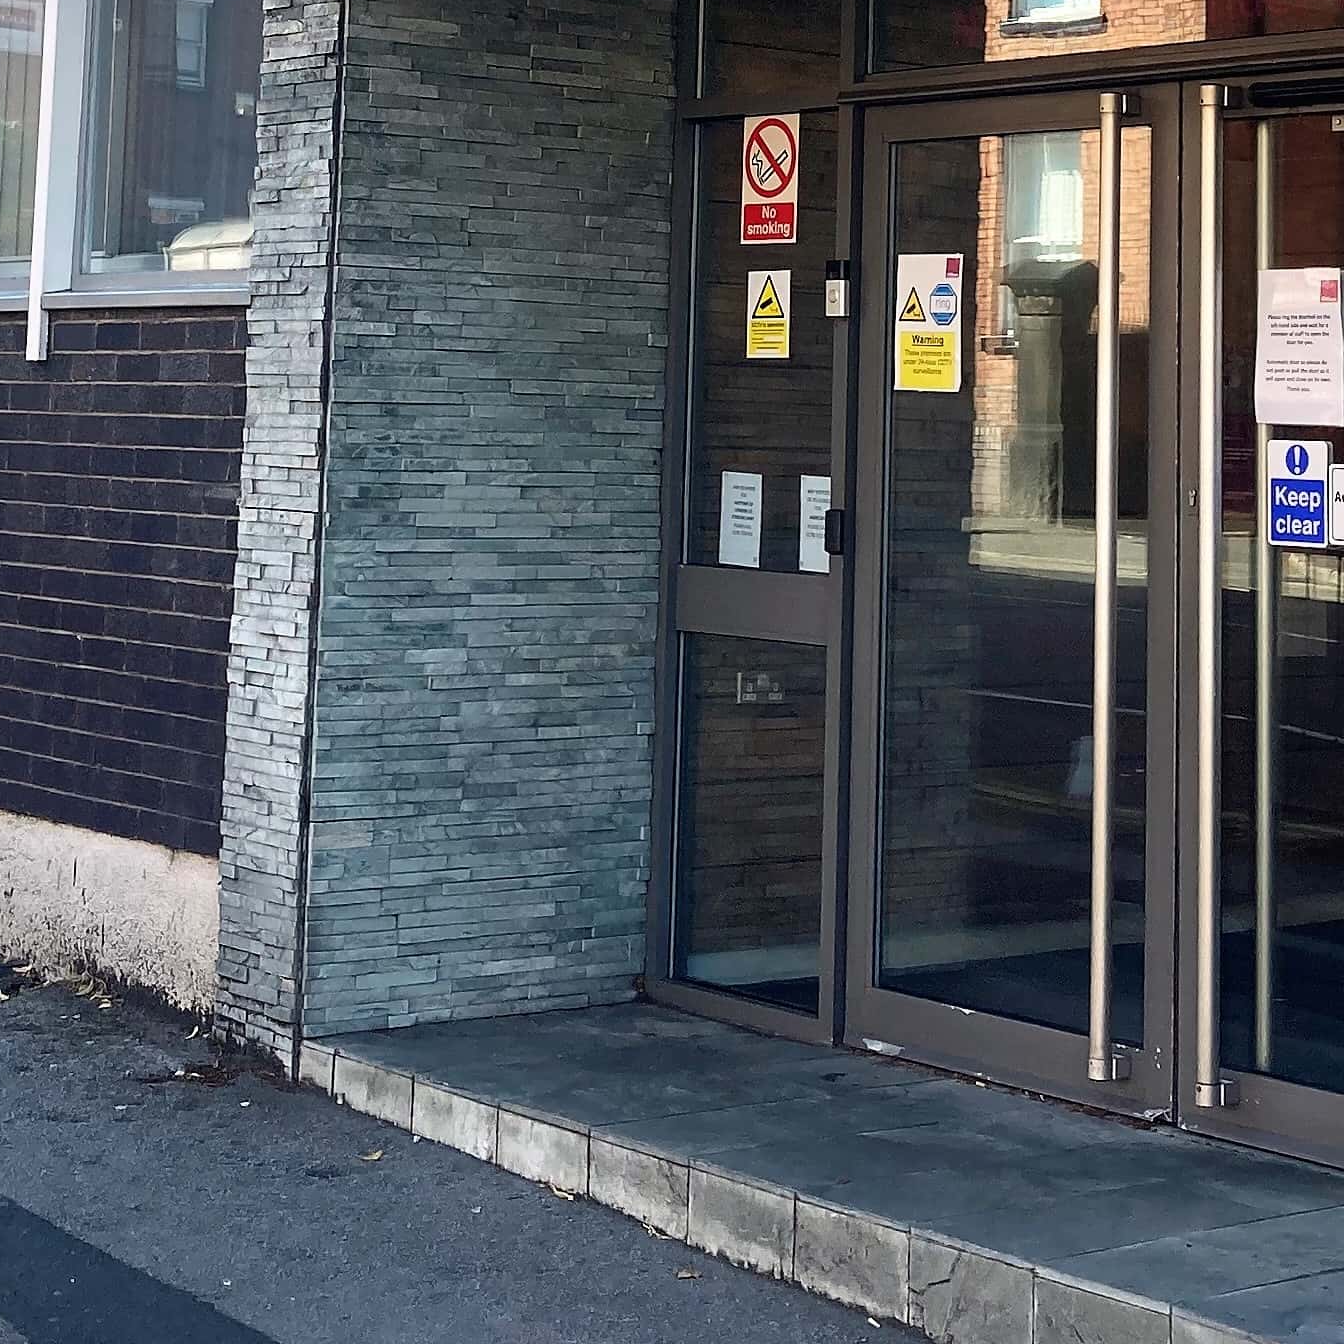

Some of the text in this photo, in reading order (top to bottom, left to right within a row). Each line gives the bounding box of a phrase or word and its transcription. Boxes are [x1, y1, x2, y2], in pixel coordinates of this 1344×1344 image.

[761, 205, 777, 219] No
[746, 220, 791, 238] smoking
[912, 334, 945, 345] Warning
[1275, 485, 1321, 513] Keep
[1276, 514, 1321, 535] clear
